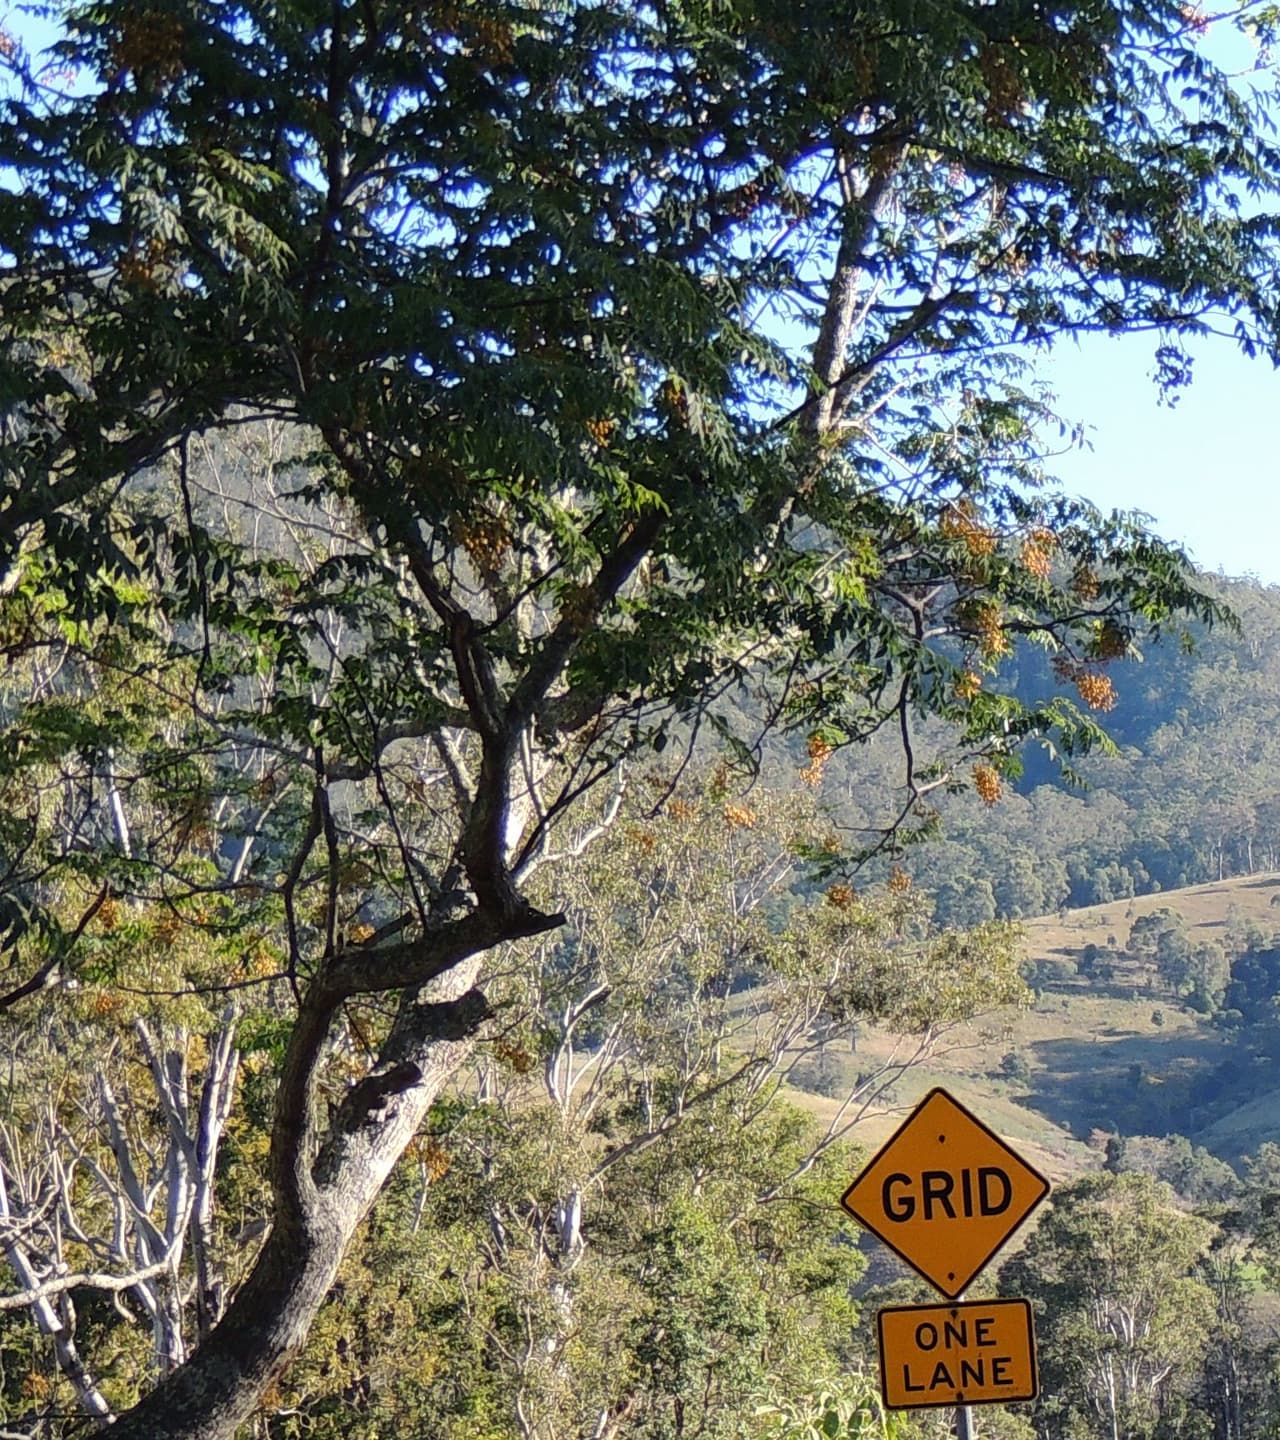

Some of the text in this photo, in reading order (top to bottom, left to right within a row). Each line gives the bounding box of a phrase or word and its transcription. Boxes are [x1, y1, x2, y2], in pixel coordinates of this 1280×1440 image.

[881, 1166, 1012, 1222] GRID
[915, 1318, 997, 1351] ONE
[903, 1357, 1014, 1392] LANE
